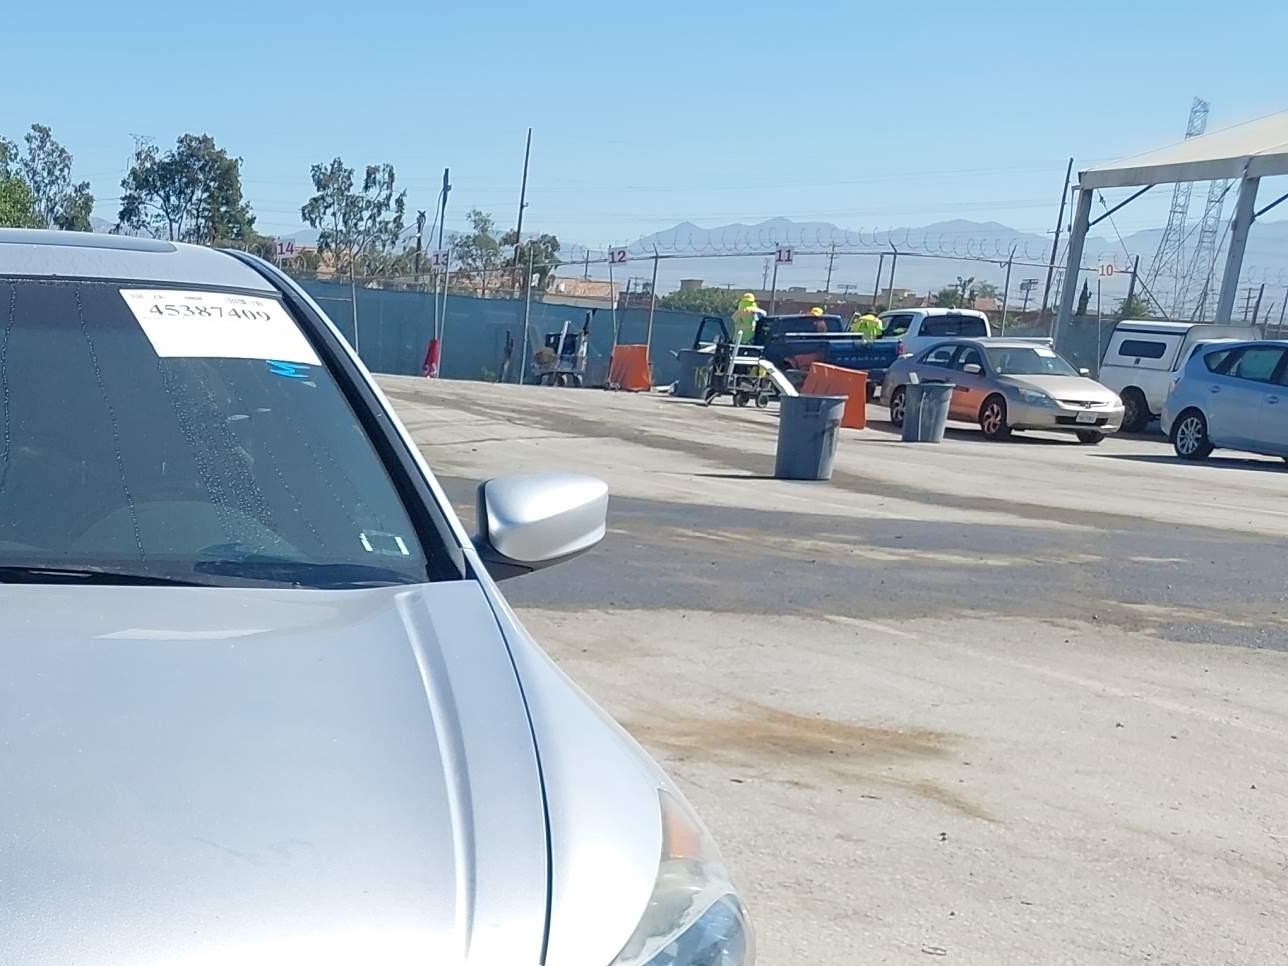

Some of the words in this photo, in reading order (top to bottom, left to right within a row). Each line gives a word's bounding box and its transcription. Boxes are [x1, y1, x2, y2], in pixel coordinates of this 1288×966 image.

[278, 241, 294, 255] 14
[432, 253, 449, 266] 13
[608, 250, 626, 264] 12
[776, 249, 792, 262] 11
[1099, 264, 1114, 276] 10
[149, 304, 272, 322] 45387409
